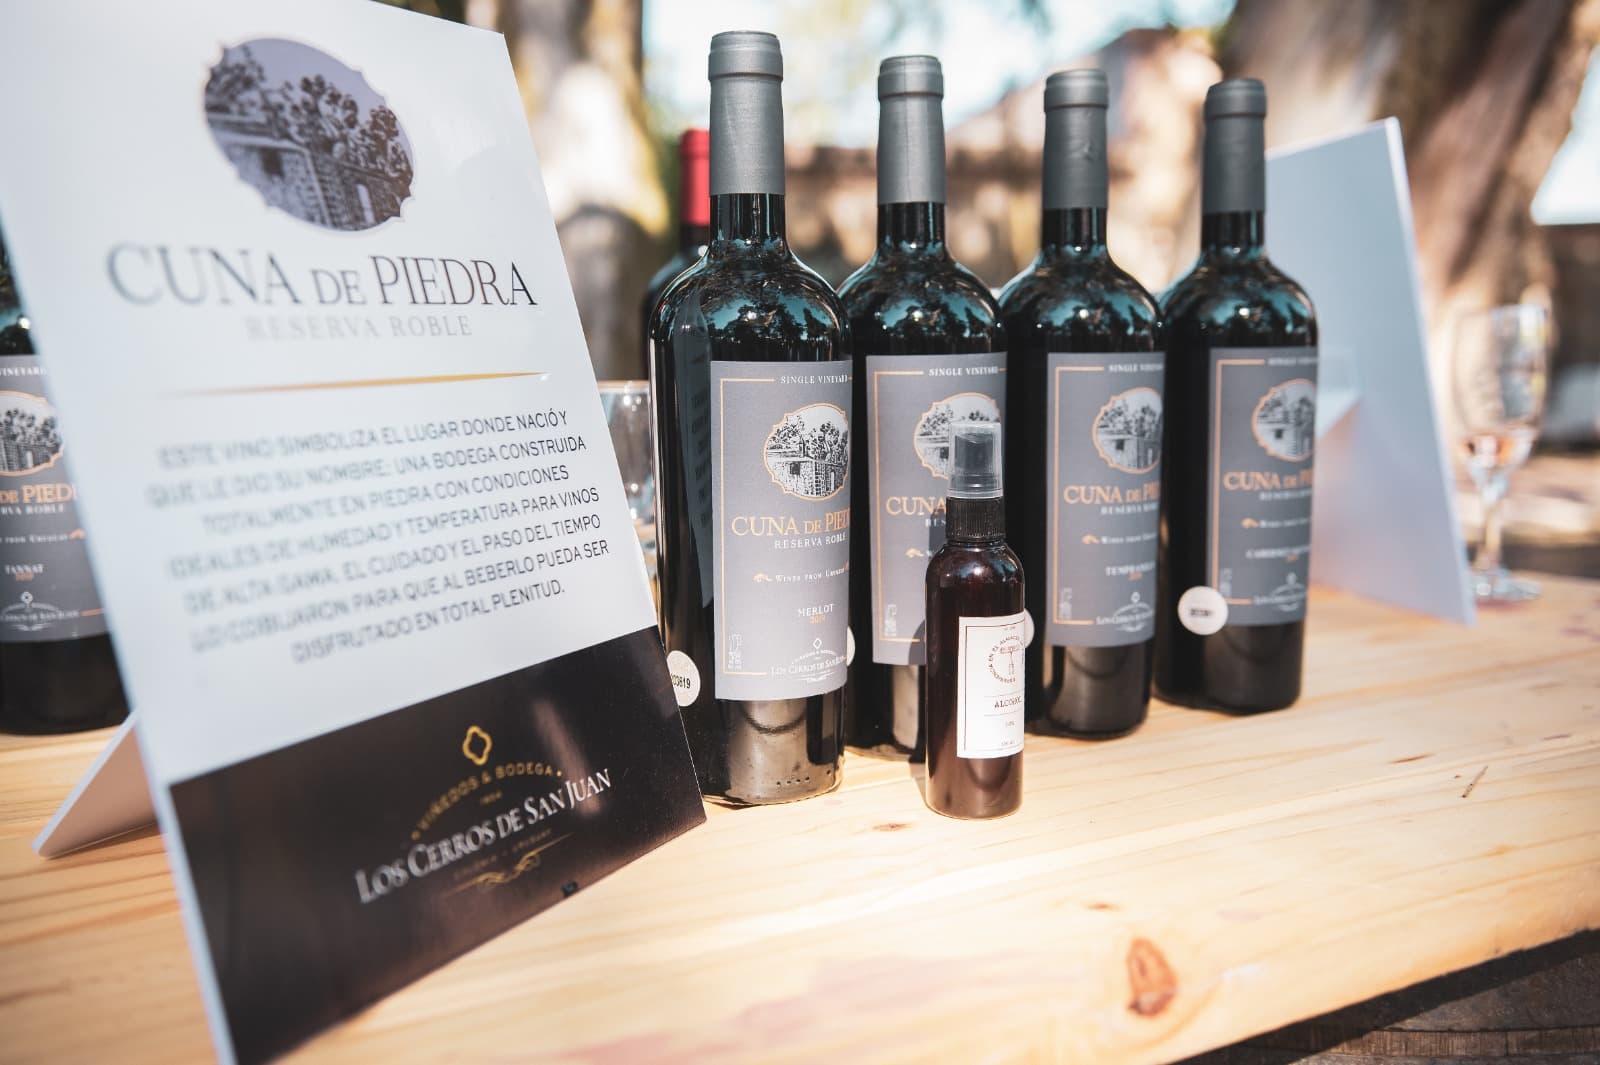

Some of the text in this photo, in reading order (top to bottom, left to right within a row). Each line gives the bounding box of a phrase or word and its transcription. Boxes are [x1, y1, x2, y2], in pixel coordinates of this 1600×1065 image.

[105, 241, 539, 308] CUNA DE PIEDRA
[245, 315, 474, 342] RESERVA ROBLE
[780, 375, 815, 384] SINGLE
[928, 367, 963, 377] SINGLE
[382, 427, 404, 445] EL
[406, 421, 460, 442] LUGAR
[462, 416, 515, 436] DONDE
[516, 408, 558, 431] NACIÓ
[558, 410, 568, 426] Y
[394, 454, 432, 475] UNA
[433, 447, 498, 470] BODEGA
[499, 435, 587, 461] CONSTRUIDA
[339, 493, 367, 515] EN
[368, 484, 431, 508] PIEDRA
[433, 479, 469, 501] CON
[471, 464, 569, 494] CONDICIONES
[1063, 485, 1123, 504] CUNA
[1224, 472, 1280, 491] CUNA
[406, 501, 519, 535] TEMPERATURA
[520, 495, 559, 516] PARA
[559, 487, 601, 508] VINOS
[731, 515, 800, 537] CUNA
[804, 519, 821, 534] DE
[342, 560, 367, 581] EL
[368, 544, 449, 576] CUIDADO
[449, 543, 461, 561] Y
[462, 538, 482, 557] EL
[483, 529, 523, 553] PASO
[524, 524, 553, 544] DEL
[551, 514, 601, 538] TIEMPO
[774, 537, 822, 549] RESERVA
[352, 586, 401, 610] PARA
[402, 576, 442, 600] QUE
[442, 571, 465, 591] AL
[464, 556, 535, 588] BEBERLO
[536, 546, 583, 570] PUEDA
[583, 539, 610, 559] SER
[290, 579, 566, 664] DISFRUTADO EN TOTAL PLENITUD.
[798, 603, 834, 617] MERLOT
[495, 763, 553, 780] BODEGA
[355, 855, 410, 904] LOS
[407, 821, 497, 878] CERROS
[496, 808, 525, 839] DE
[523, 788, 566, 825] SAN
[564, 768, 613, 809] JUAN
